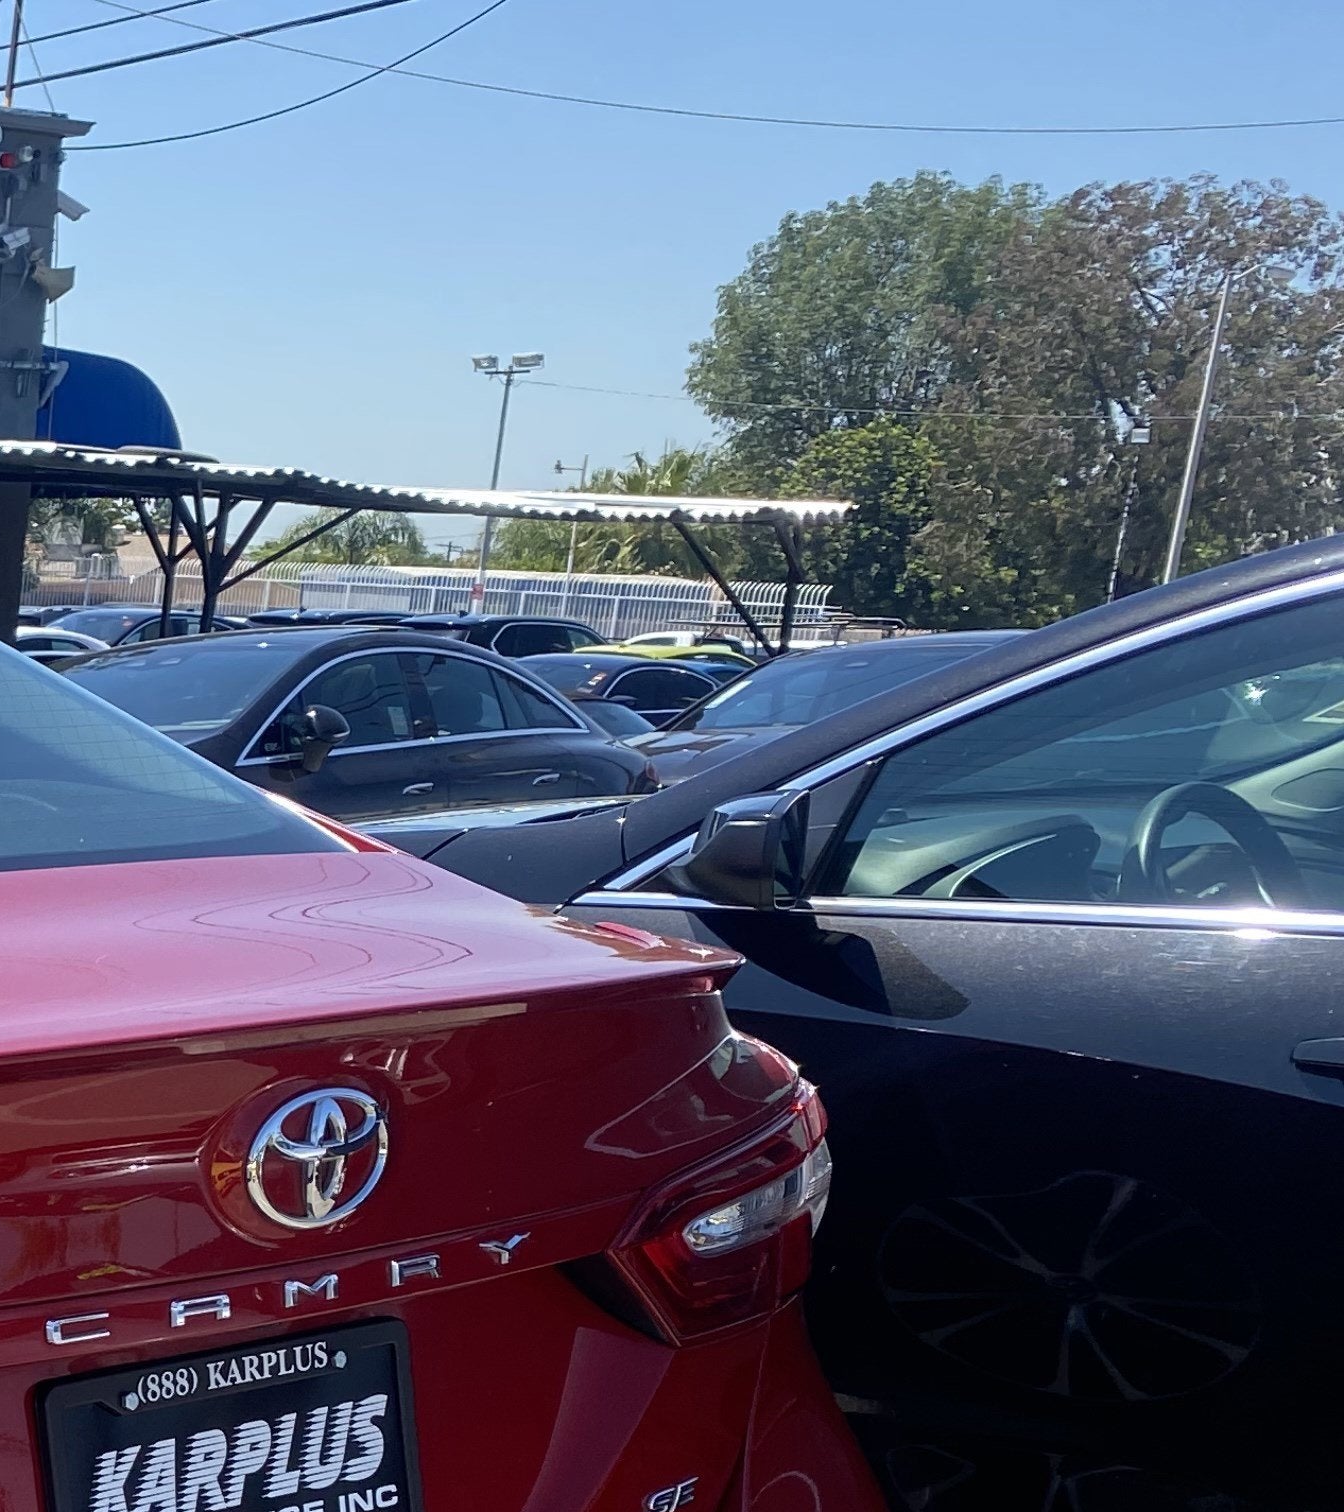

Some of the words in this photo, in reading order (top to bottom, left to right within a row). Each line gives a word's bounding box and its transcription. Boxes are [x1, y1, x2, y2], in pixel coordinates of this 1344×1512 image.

[44, 1231, 531, 1346] CAMRY
[137, 1367, 198, 1404] (888)
[207, 1341, 328, 1391] KARPLUS
